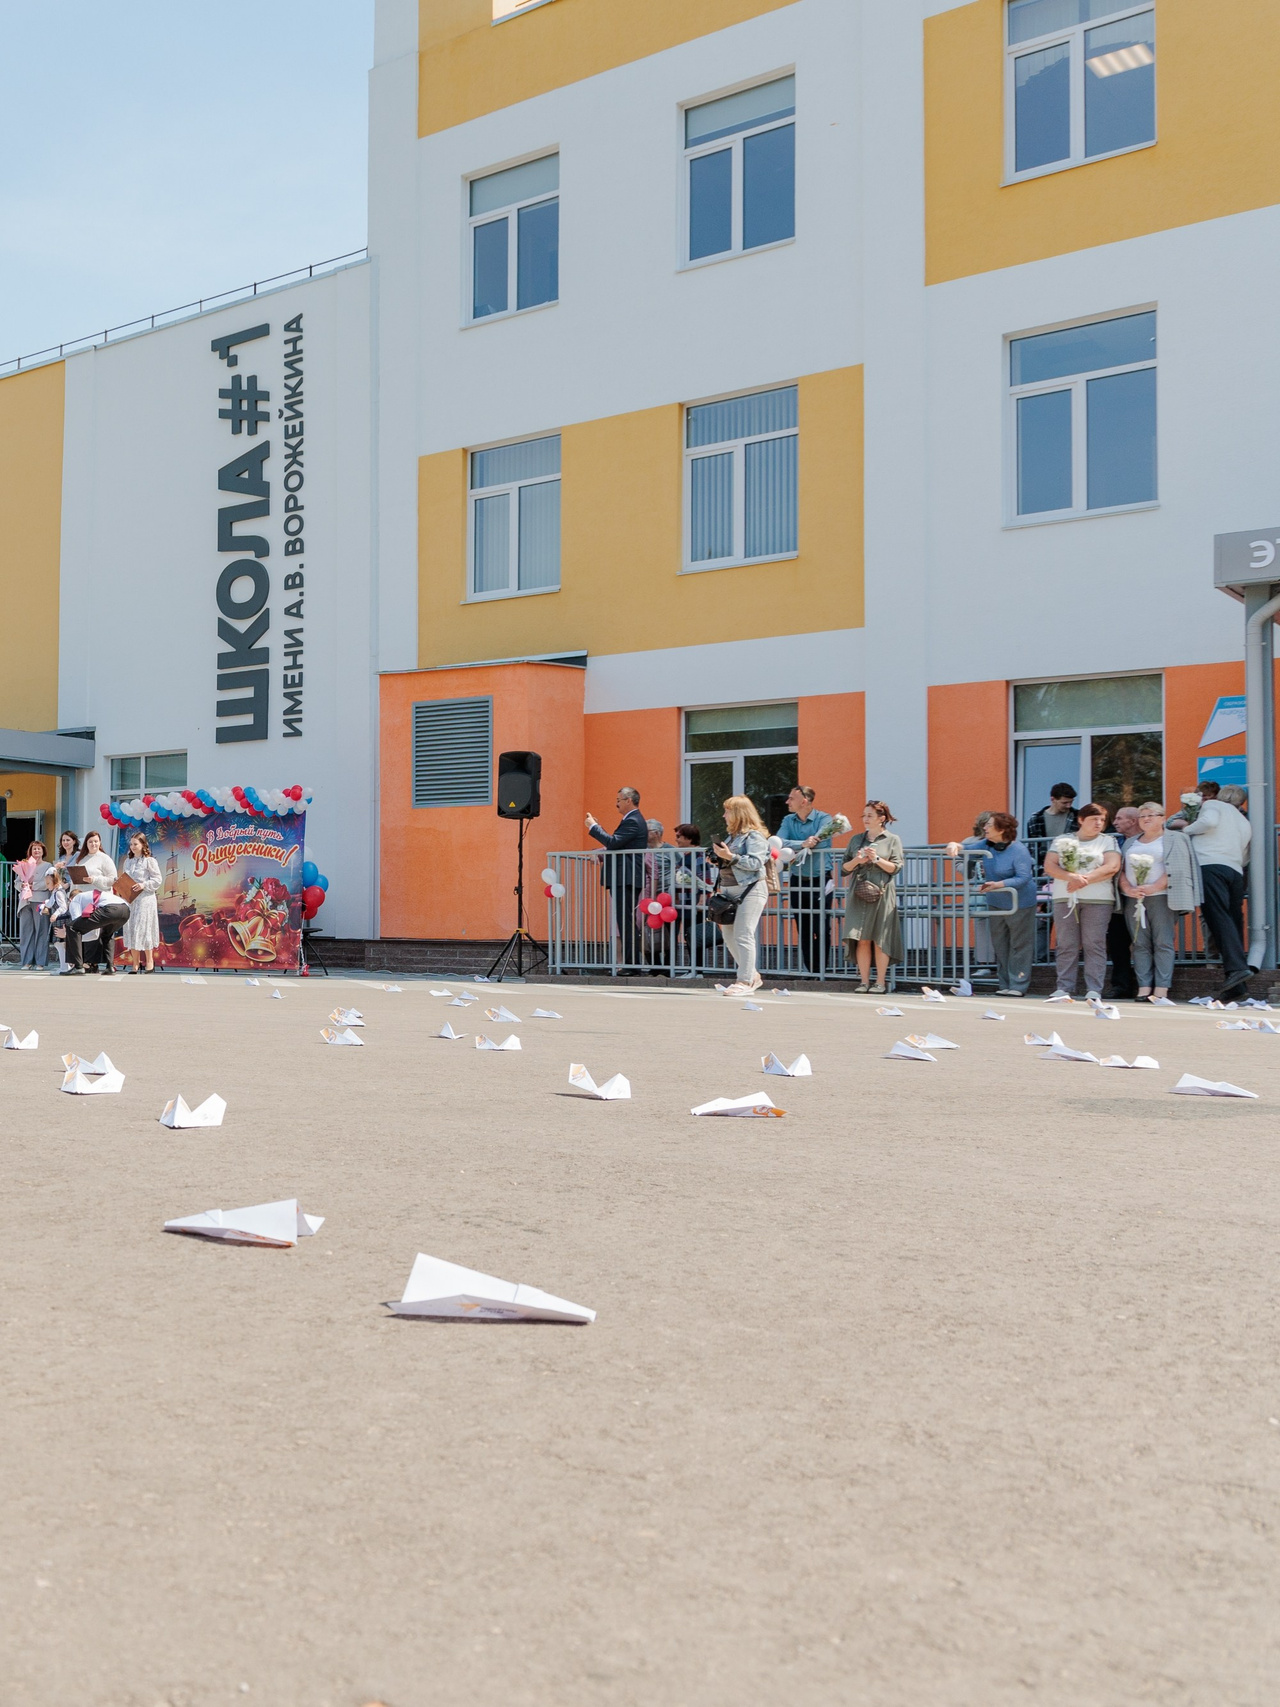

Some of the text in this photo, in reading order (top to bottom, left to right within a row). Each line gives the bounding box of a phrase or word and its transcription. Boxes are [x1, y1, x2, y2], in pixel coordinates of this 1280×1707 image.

[278, 313, 305, 738] ИМЕНИ А.В. ВОРОЖЕЙКИНА
[1249, 537, 1280, 569] Э
[256, 828, 284, 841] путь
[192, 842, 299, 877] Выпускники!
